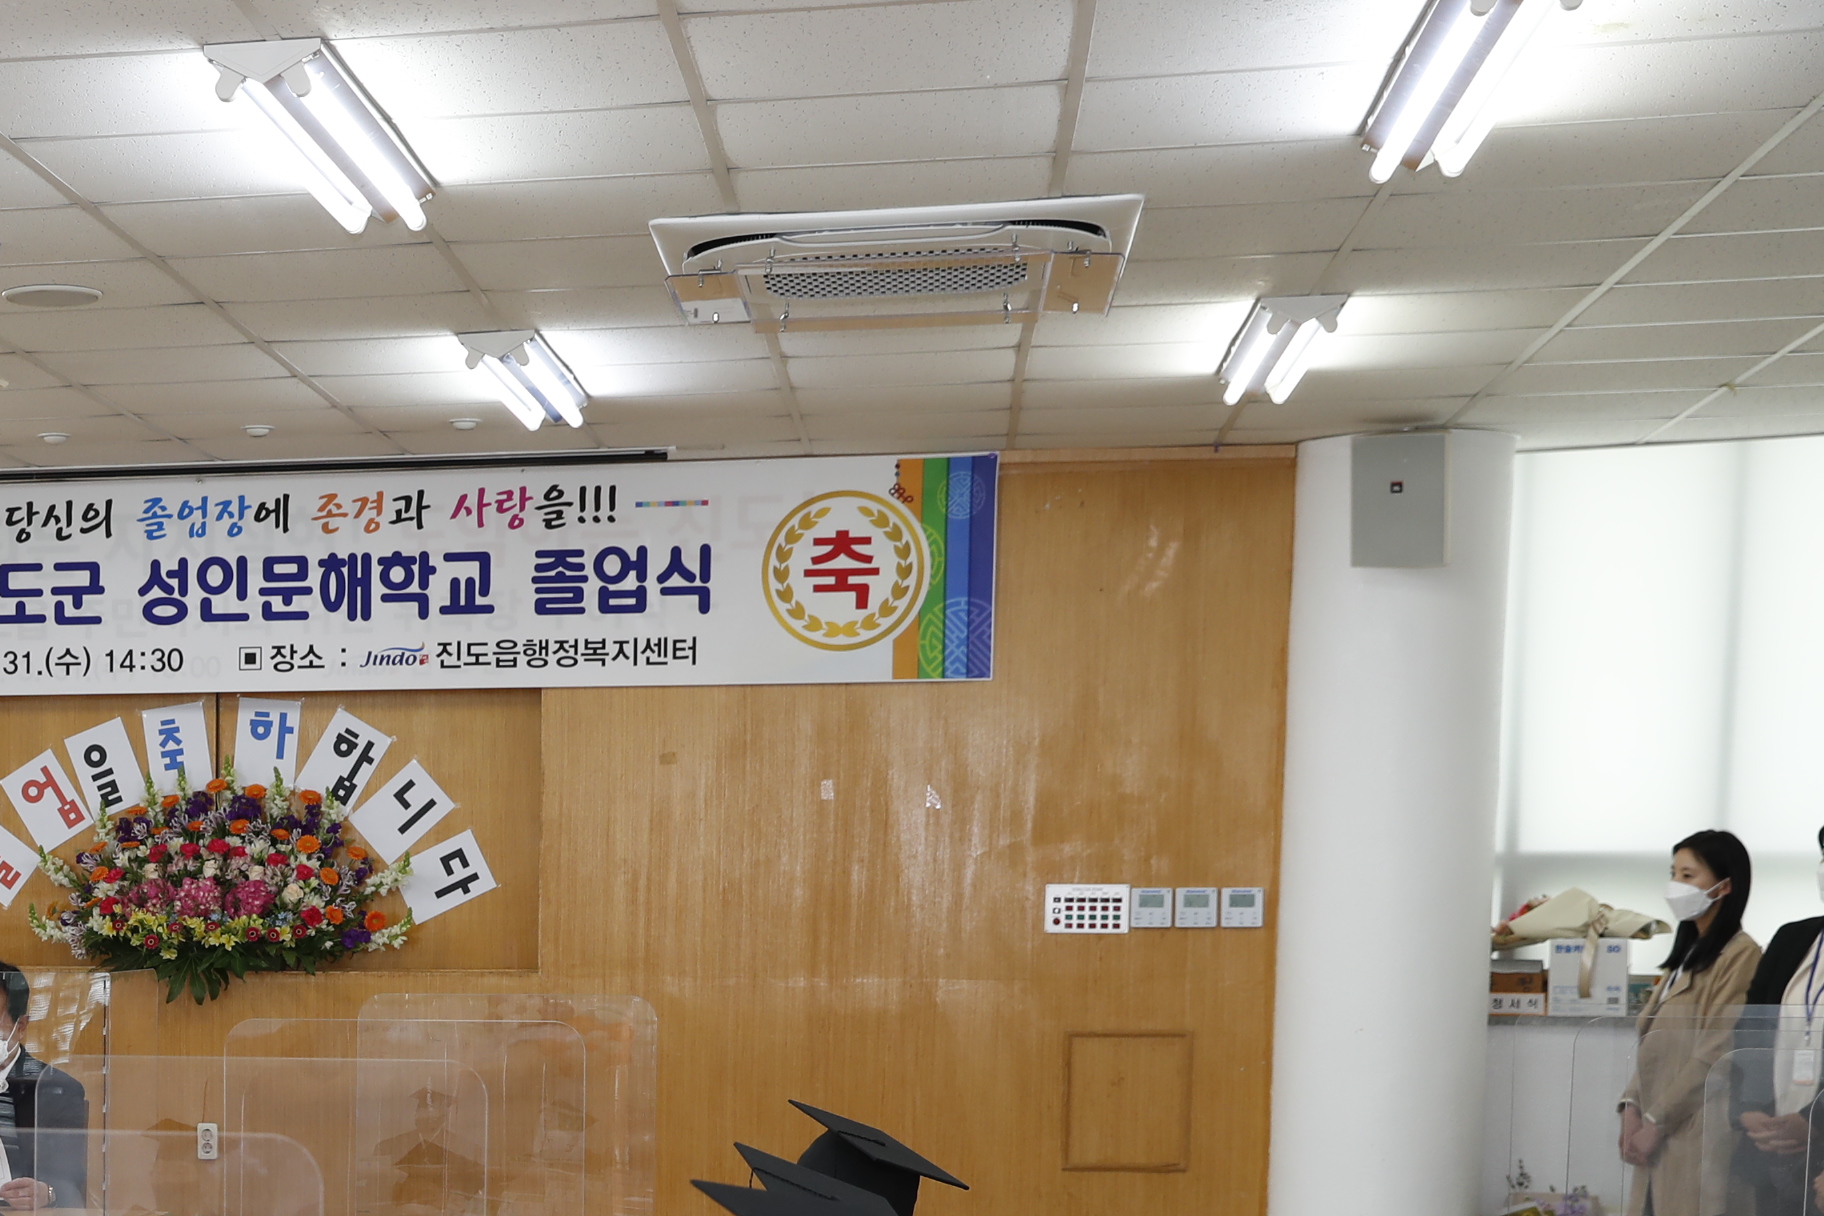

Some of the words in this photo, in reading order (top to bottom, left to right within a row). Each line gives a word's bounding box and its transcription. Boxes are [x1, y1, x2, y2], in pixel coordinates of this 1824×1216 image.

[4, 498, 113, 544] 당신의
[136, 492, 290, 541] 졸업장에
[310, 488, 432, 535] 존경과
[449, 483, 617, 531] 사랑을!!!
[137, 550, 496, 626] 성인문해학교
[530, 543, 712, 616] 졸업식
[803, 529, 880, 610] 축
[104, 647, 184, 673] 14:30
[269, 643, 326, 673] 장소
[435, 635, 697, 669] 진도읍행정복지센터
